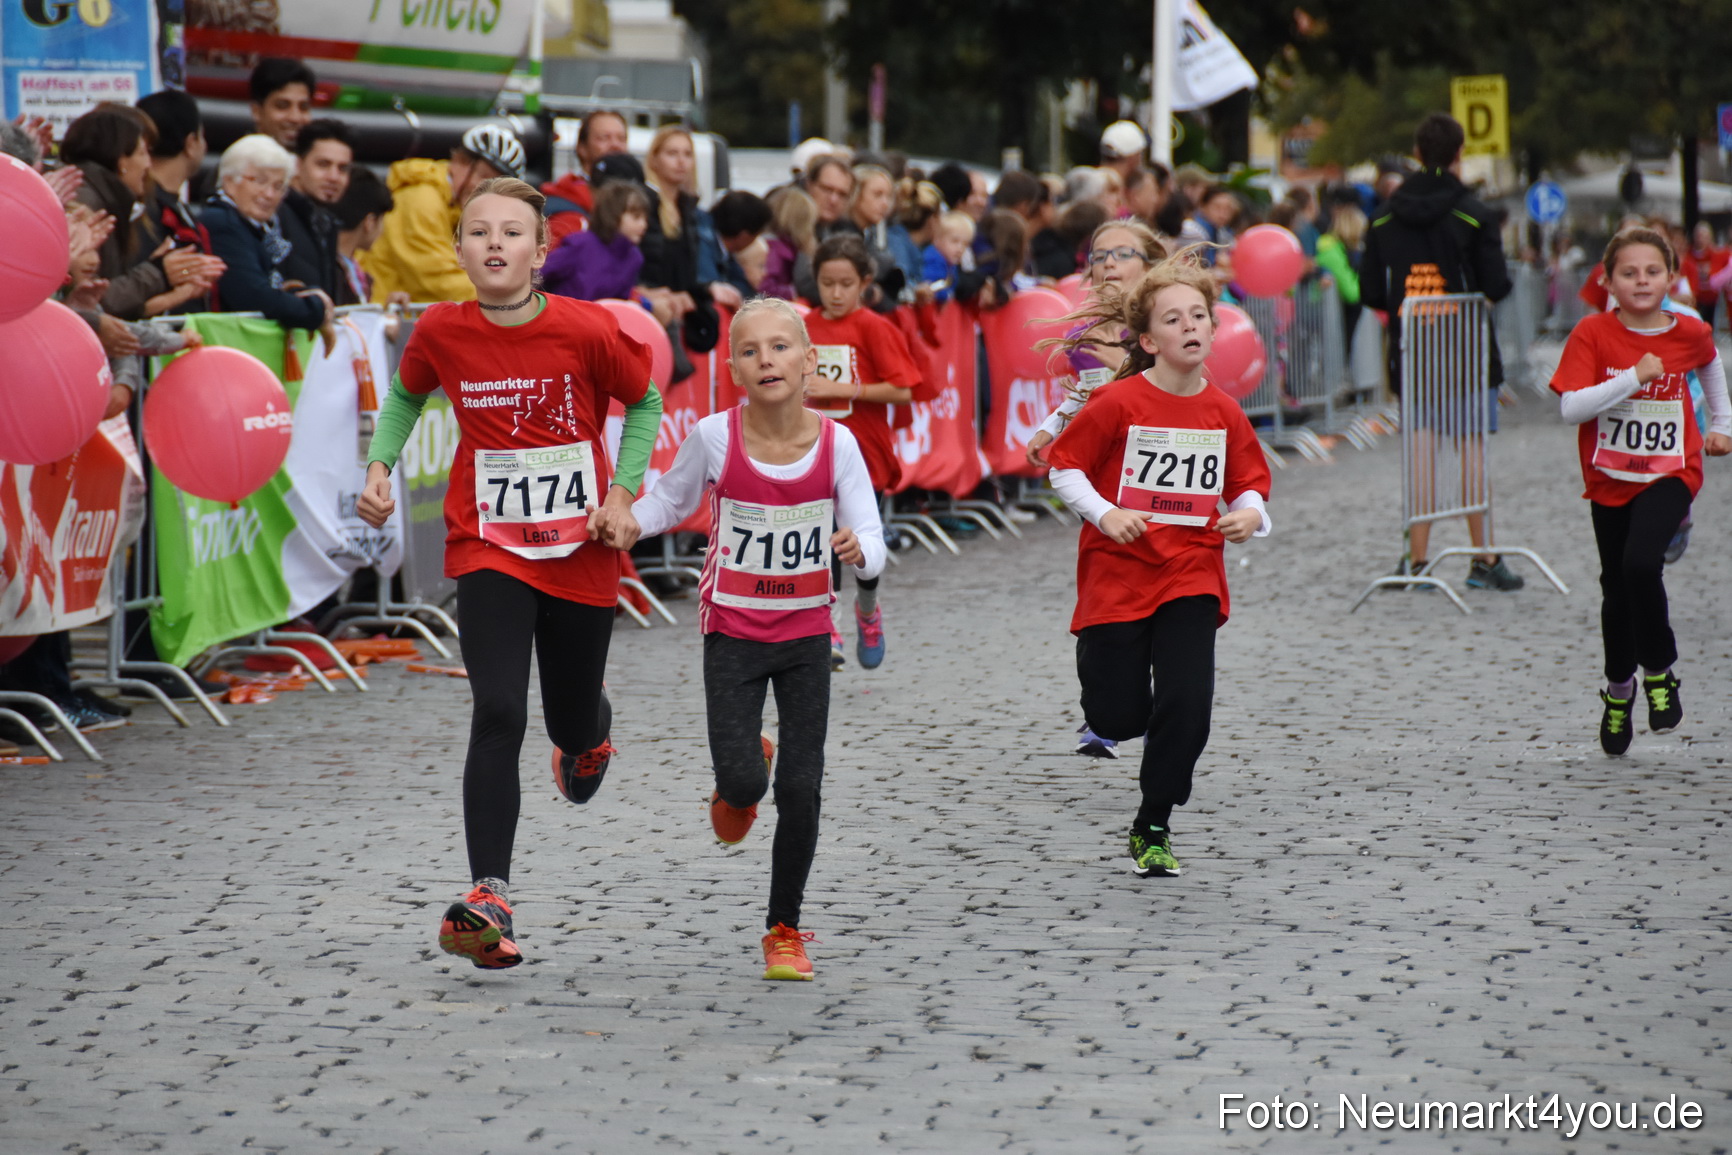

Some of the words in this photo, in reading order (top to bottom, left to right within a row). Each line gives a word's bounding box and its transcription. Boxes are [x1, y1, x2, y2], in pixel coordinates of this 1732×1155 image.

[1467, 103, 1492, 140] D
[460, 377, 536, 392] Neumarkter
[462, 393, 521, 409] Stadtlauf
[564, 373, 578, 437] BAMBINI
[1175, 432, 1221, 446] BOCK
[1607, 417, 1677, 451] 7093
[484, 461, 520, 469] NeuerMarkt
[525, 447, 584, 466] BOCK
[1137, 449, 1218, 490] 7218
[487, 470, 588, 517] 7174
[1151, 495, 1193, 513] Emma
[729, 510, 767, 524] NeuerMarkt
[773, 503, 825, 523] BOCK
[522, 527, 560, 544] Lena
[732, 525, 823, 570] 7194
[754, 579, 796, 595] Alina
